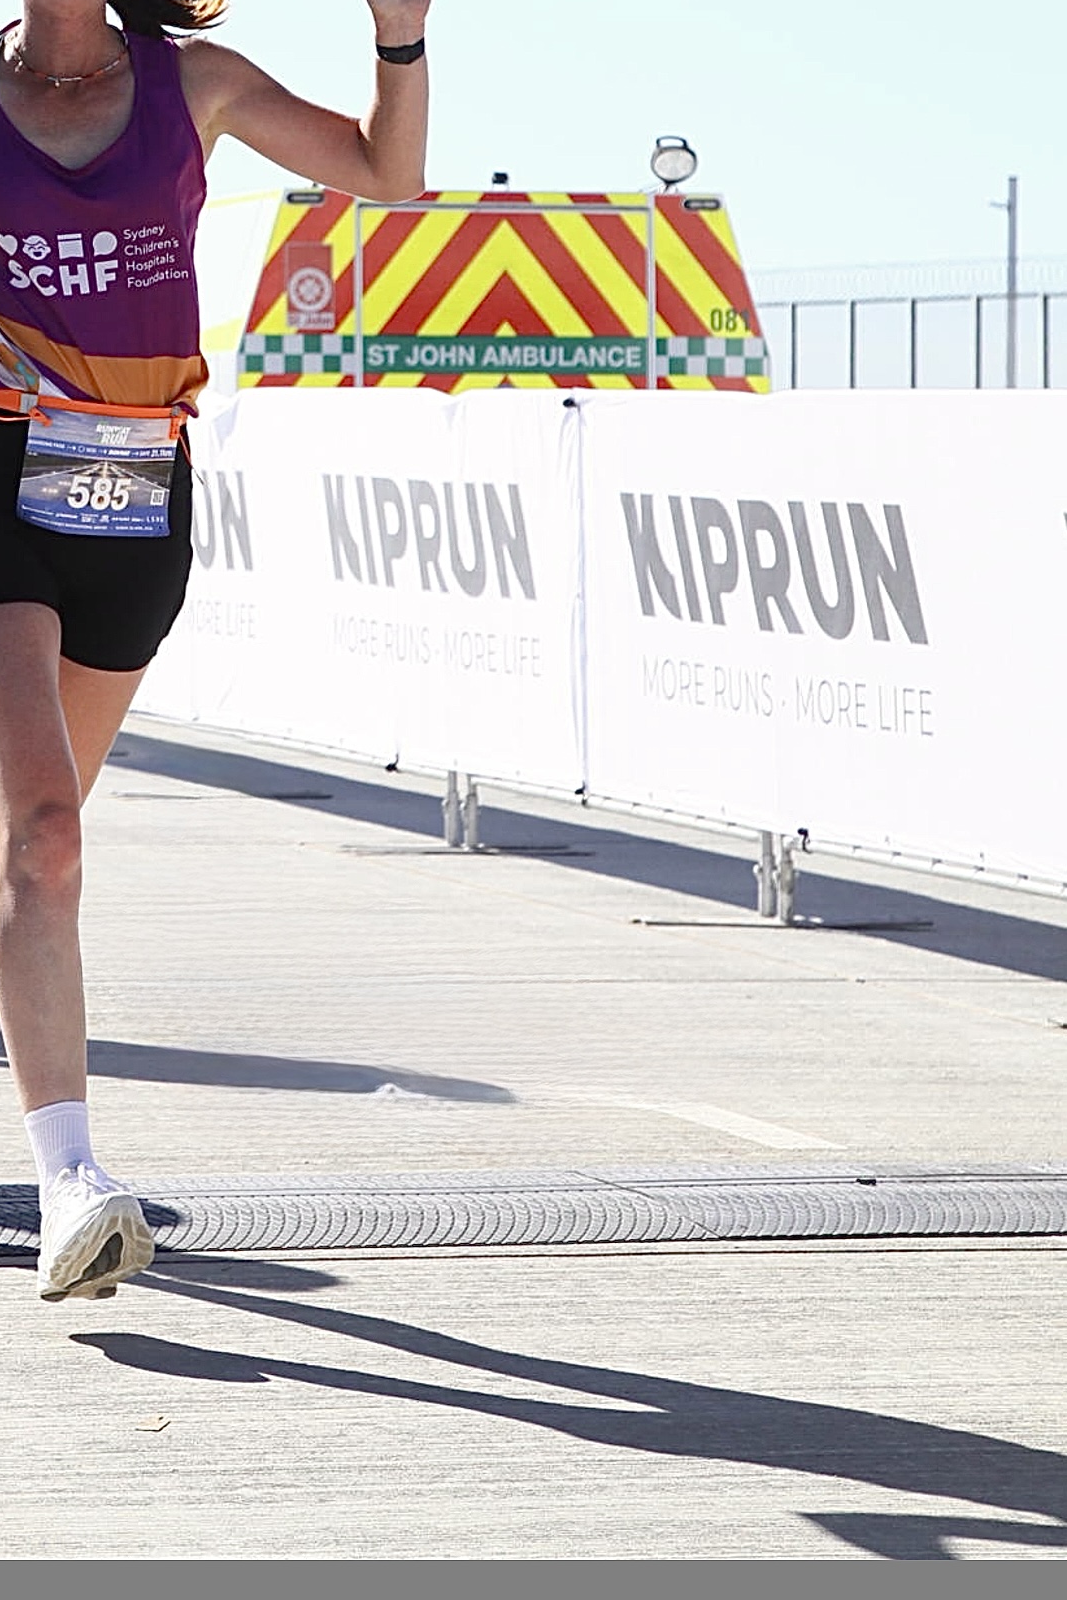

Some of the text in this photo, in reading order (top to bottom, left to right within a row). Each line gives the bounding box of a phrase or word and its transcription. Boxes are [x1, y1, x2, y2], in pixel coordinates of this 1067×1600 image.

[123, 225, 165, 241] Sydney
[124, 237, 179, 256] Children's
[7, 259, 118, 296] SCHF
[126, 253, 175, 272] Hospitals
[127, 268, 189, 288] Foundation
[710, 309, 751, 332] 081
[367, 344, 642, 368] ST JOHN AMBULANCE
[67, 475, 131, 511] 585
[323, 474, 536, 600] KIPRUN
[620, 492, 929, 645] KIPRUN
[333, 613, 542, 677] MORE RUNS MORE LIFE
[642, 654, 933, 736] MORE RUNS MORE LIFE
